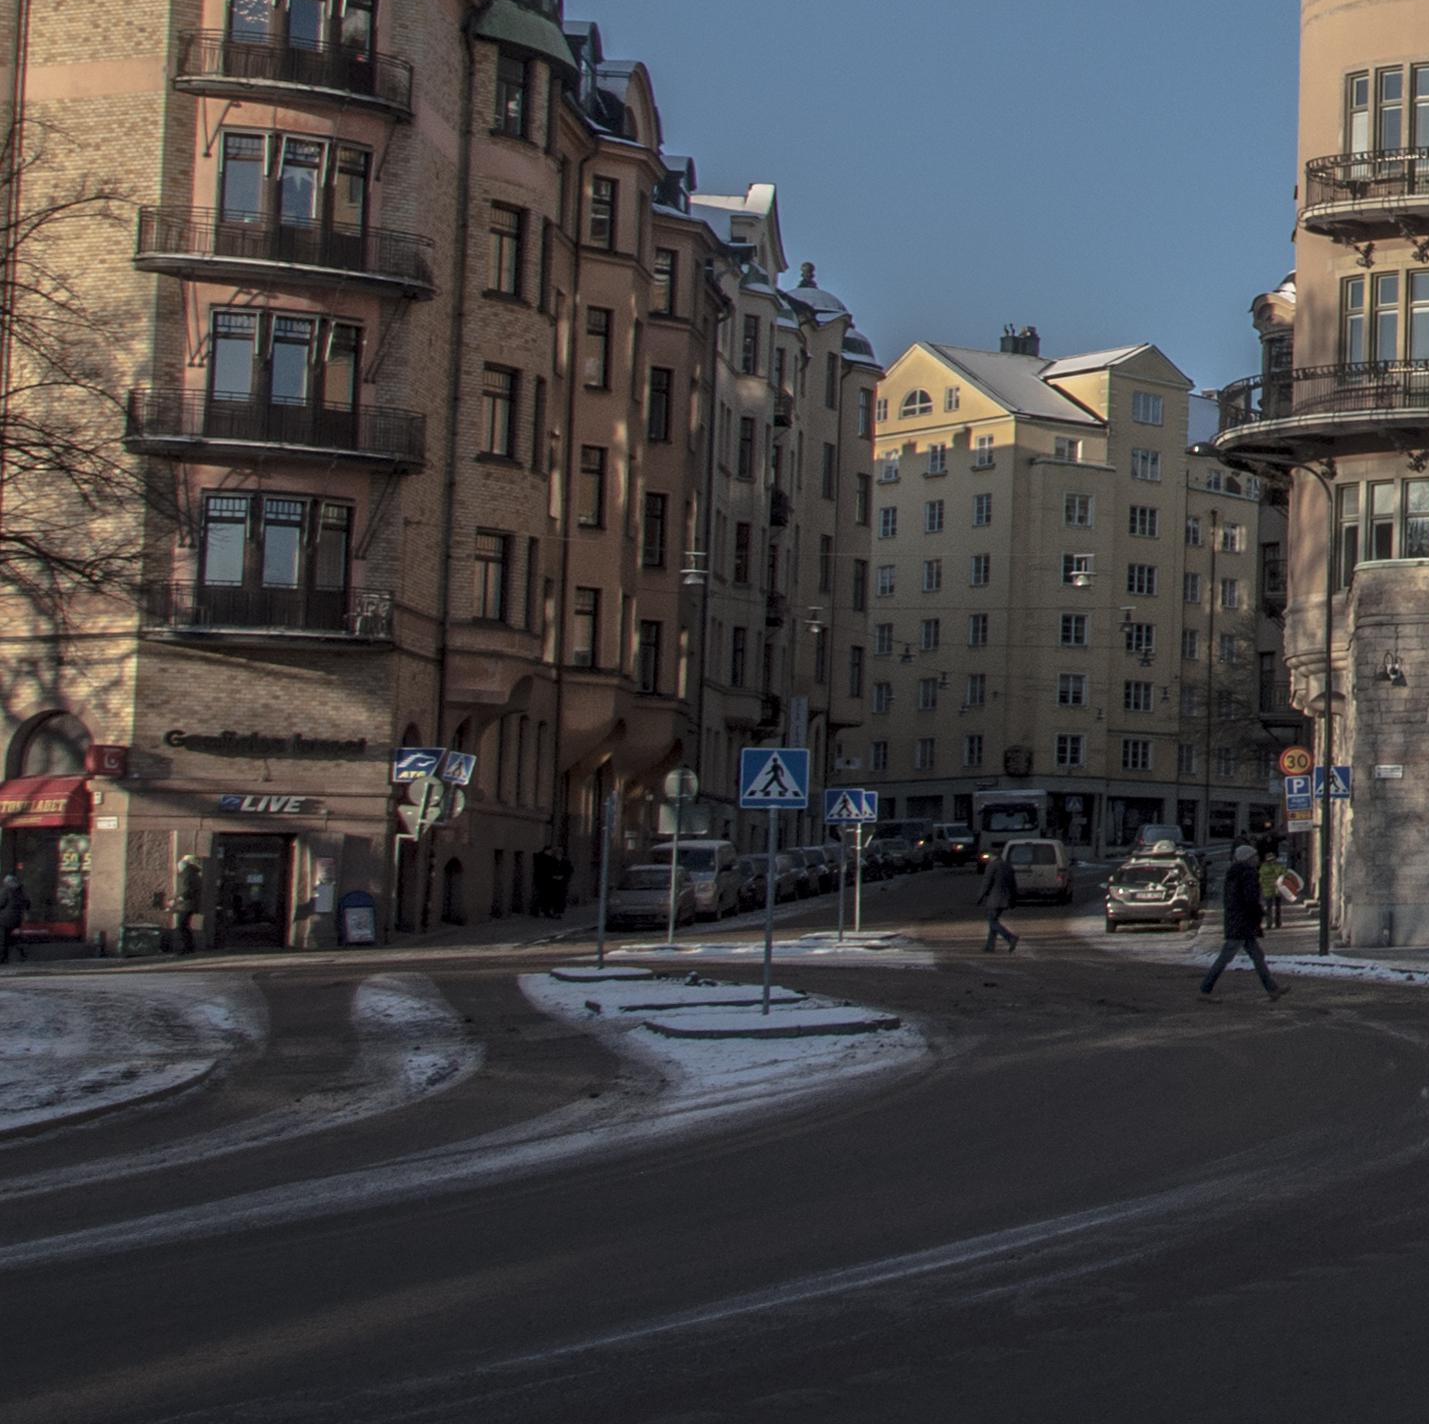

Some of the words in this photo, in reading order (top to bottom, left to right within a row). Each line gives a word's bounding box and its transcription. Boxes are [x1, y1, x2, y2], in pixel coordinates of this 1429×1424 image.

[1283, 754, 1308, 769] 30
[1293, 778, 1305, 794] P
[240, 795, 306, 812] LIVE
